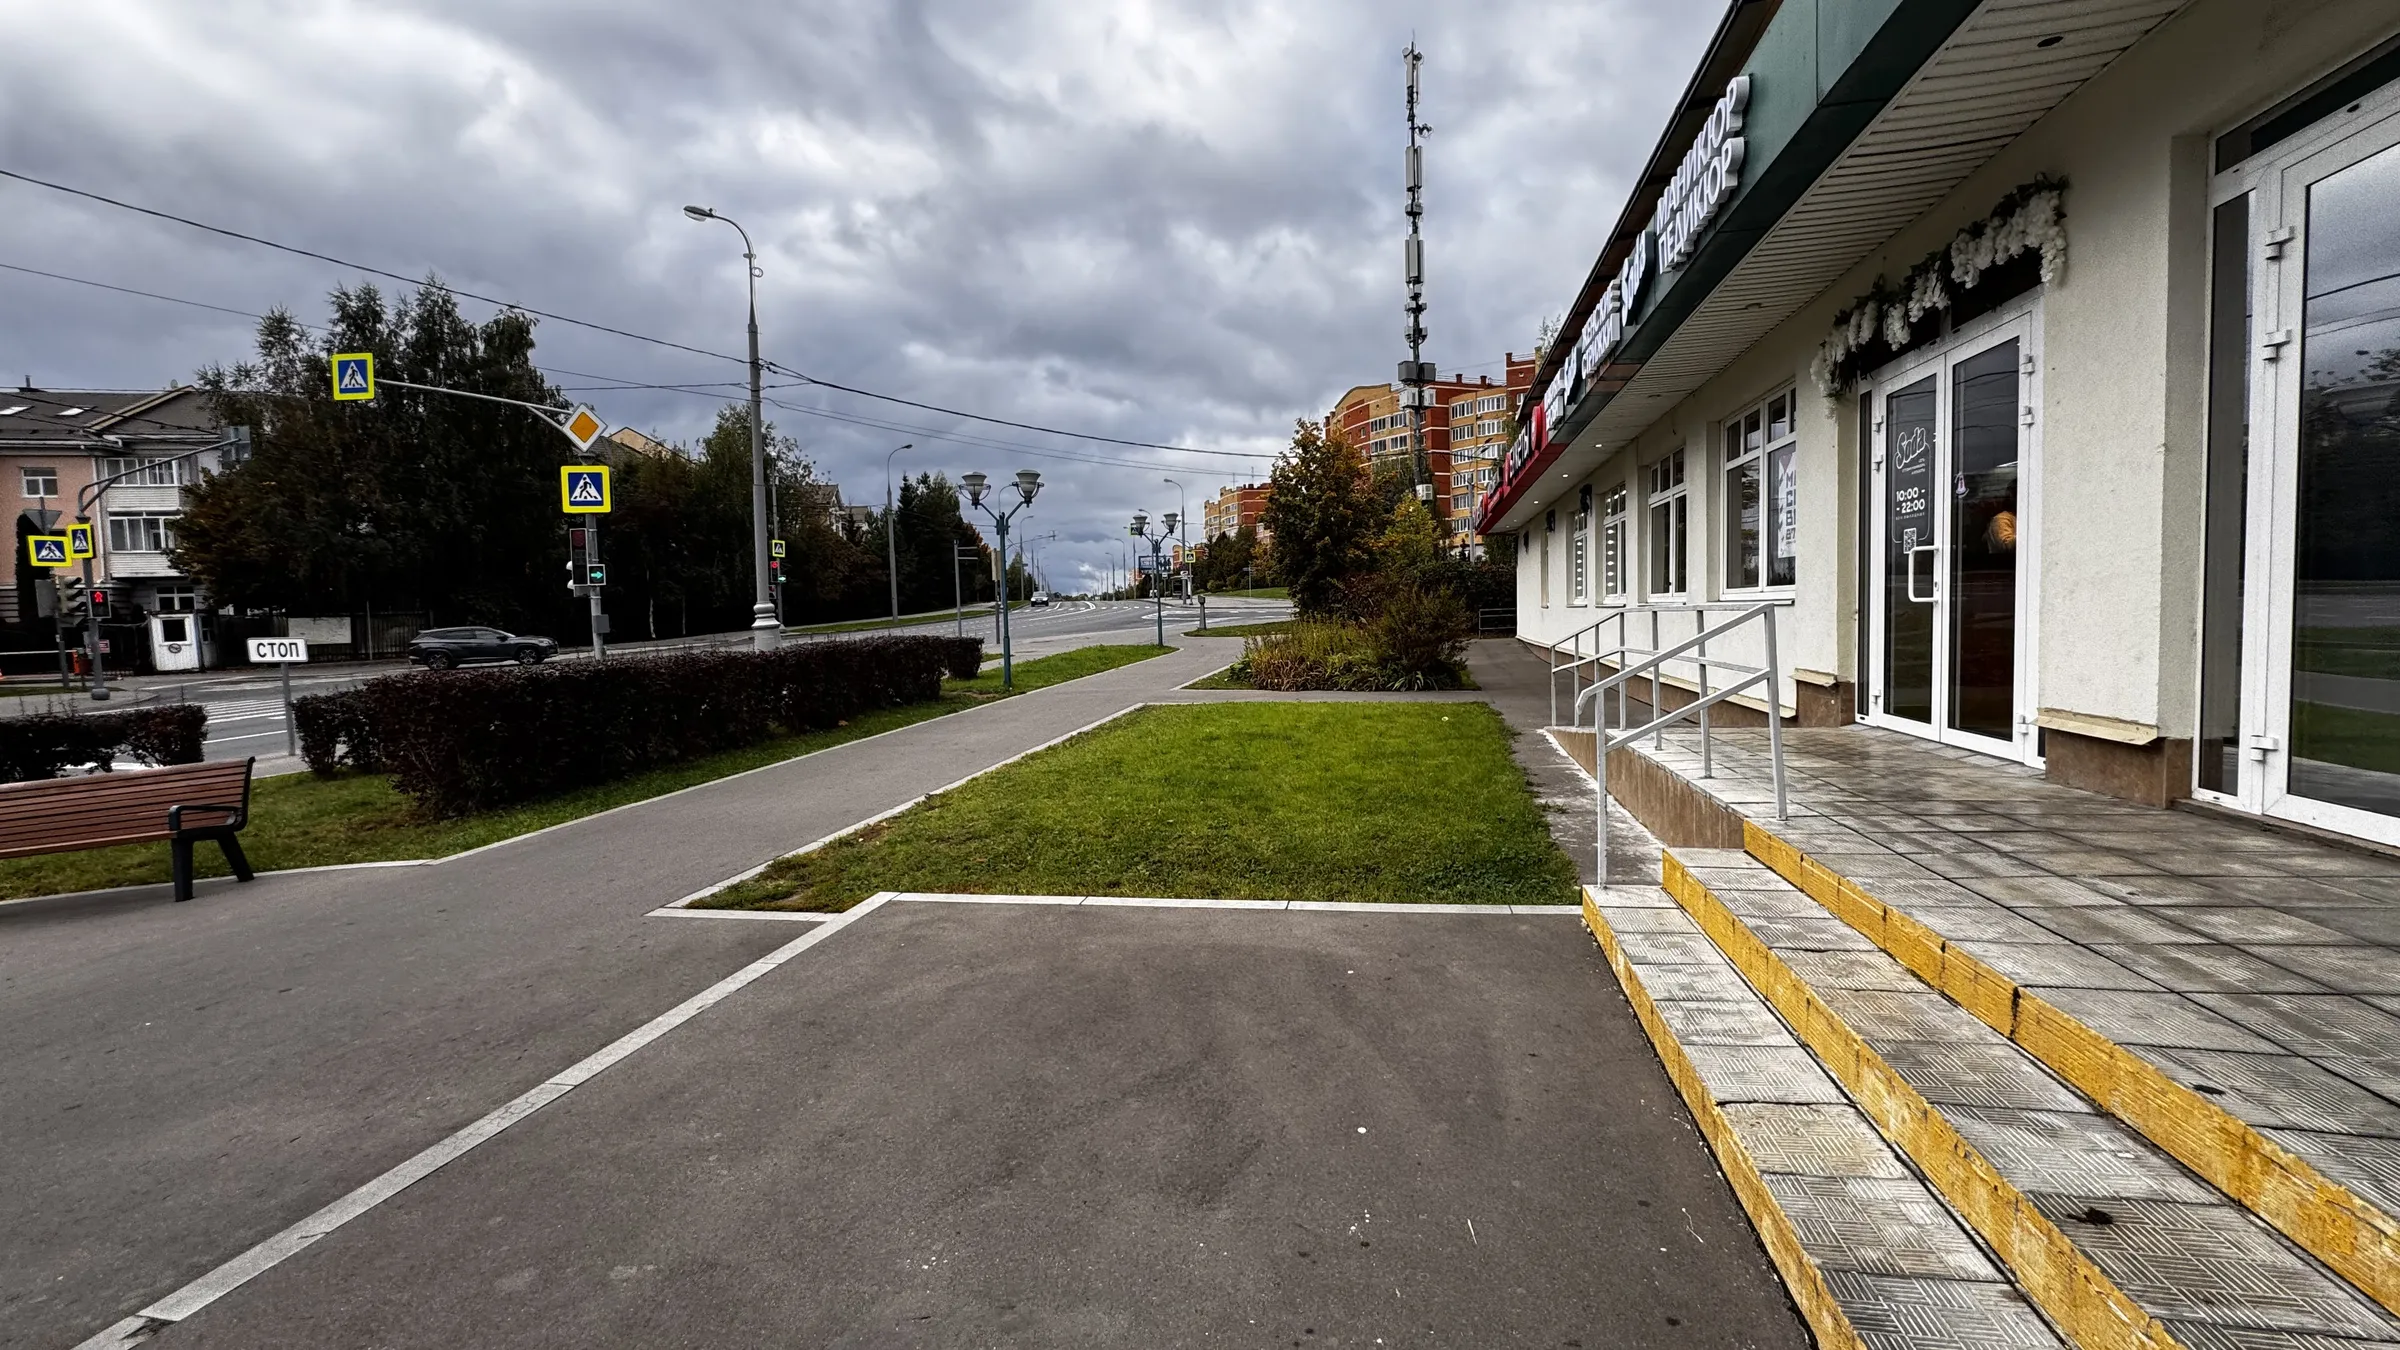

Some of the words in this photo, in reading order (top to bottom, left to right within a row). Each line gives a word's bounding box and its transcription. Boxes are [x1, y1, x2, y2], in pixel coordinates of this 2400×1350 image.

[1656, 76, 1749, 236] МАНИКЮР
[1658, 137, 1744, 274] ПЕДИКЮР
[1622, 230, 1648, 327] Soda
[1896, 427, 1926, 470] Soda
[1896, 487, 1918, 502] 10:00
[1901, 499, 1926, 514] 22:00
[256, 642, 300, 658] СТОП
